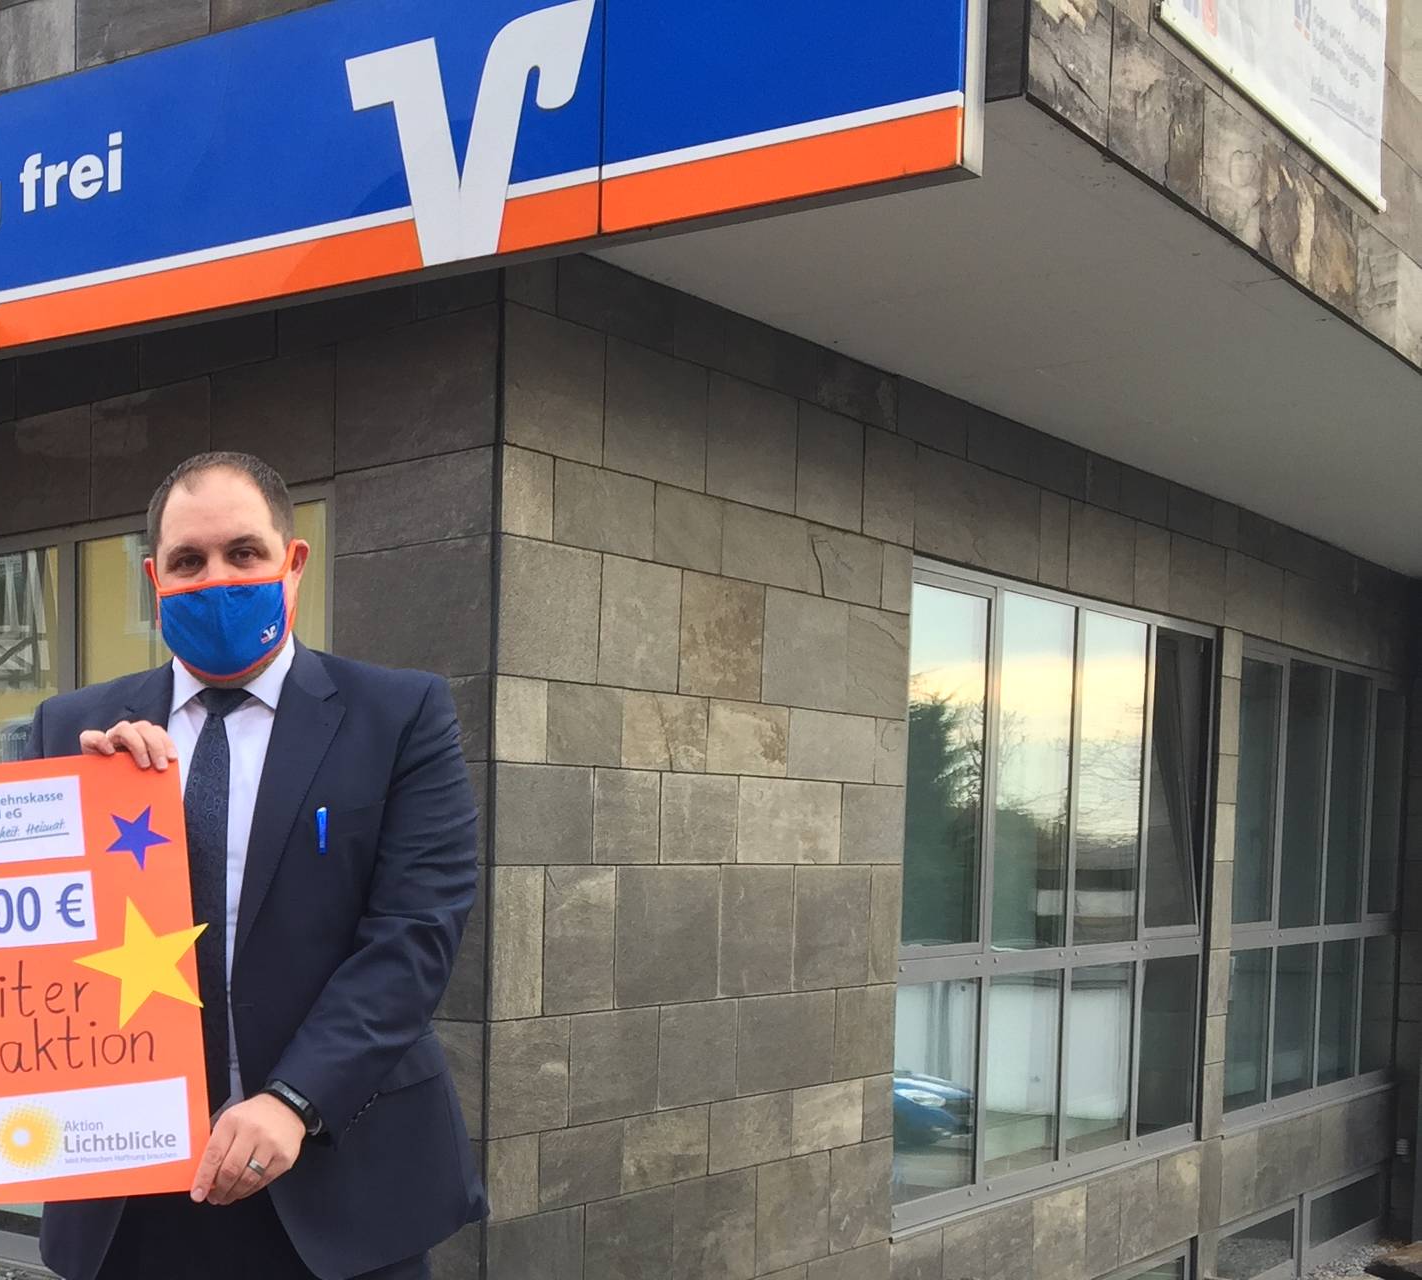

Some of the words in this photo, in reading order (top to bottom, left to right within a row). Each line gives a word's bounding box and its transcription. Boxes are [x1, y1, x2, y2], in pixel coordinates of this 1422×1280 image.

[19, 131, 123, 213] frei
[5, 808, 23, 820] eG
[55, 883, 86, 929] €
[64, 1120, 104, 1132] Aktion
[64, 1130, 177, 1154] Lichtblicke
